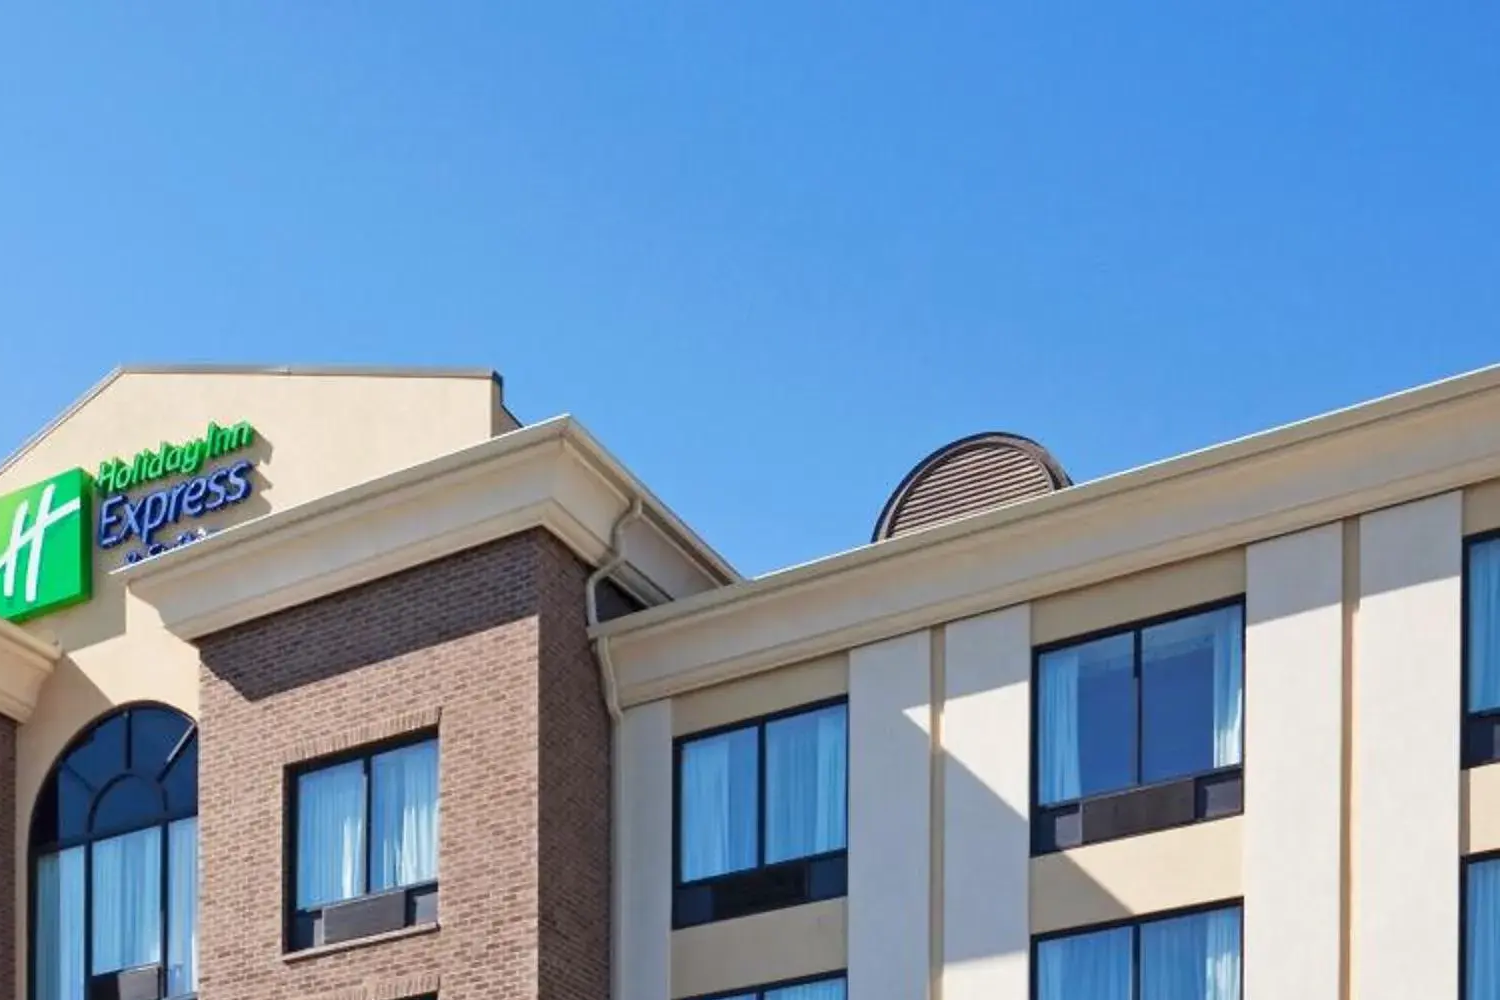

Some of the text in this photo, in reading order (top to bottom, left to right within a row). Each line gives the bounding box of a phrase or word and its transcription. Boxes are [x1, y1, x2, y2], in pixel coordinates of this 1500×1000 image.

[96, 419, 253, 492] Holiday Inn
[97, 460, 254, 548] Express
